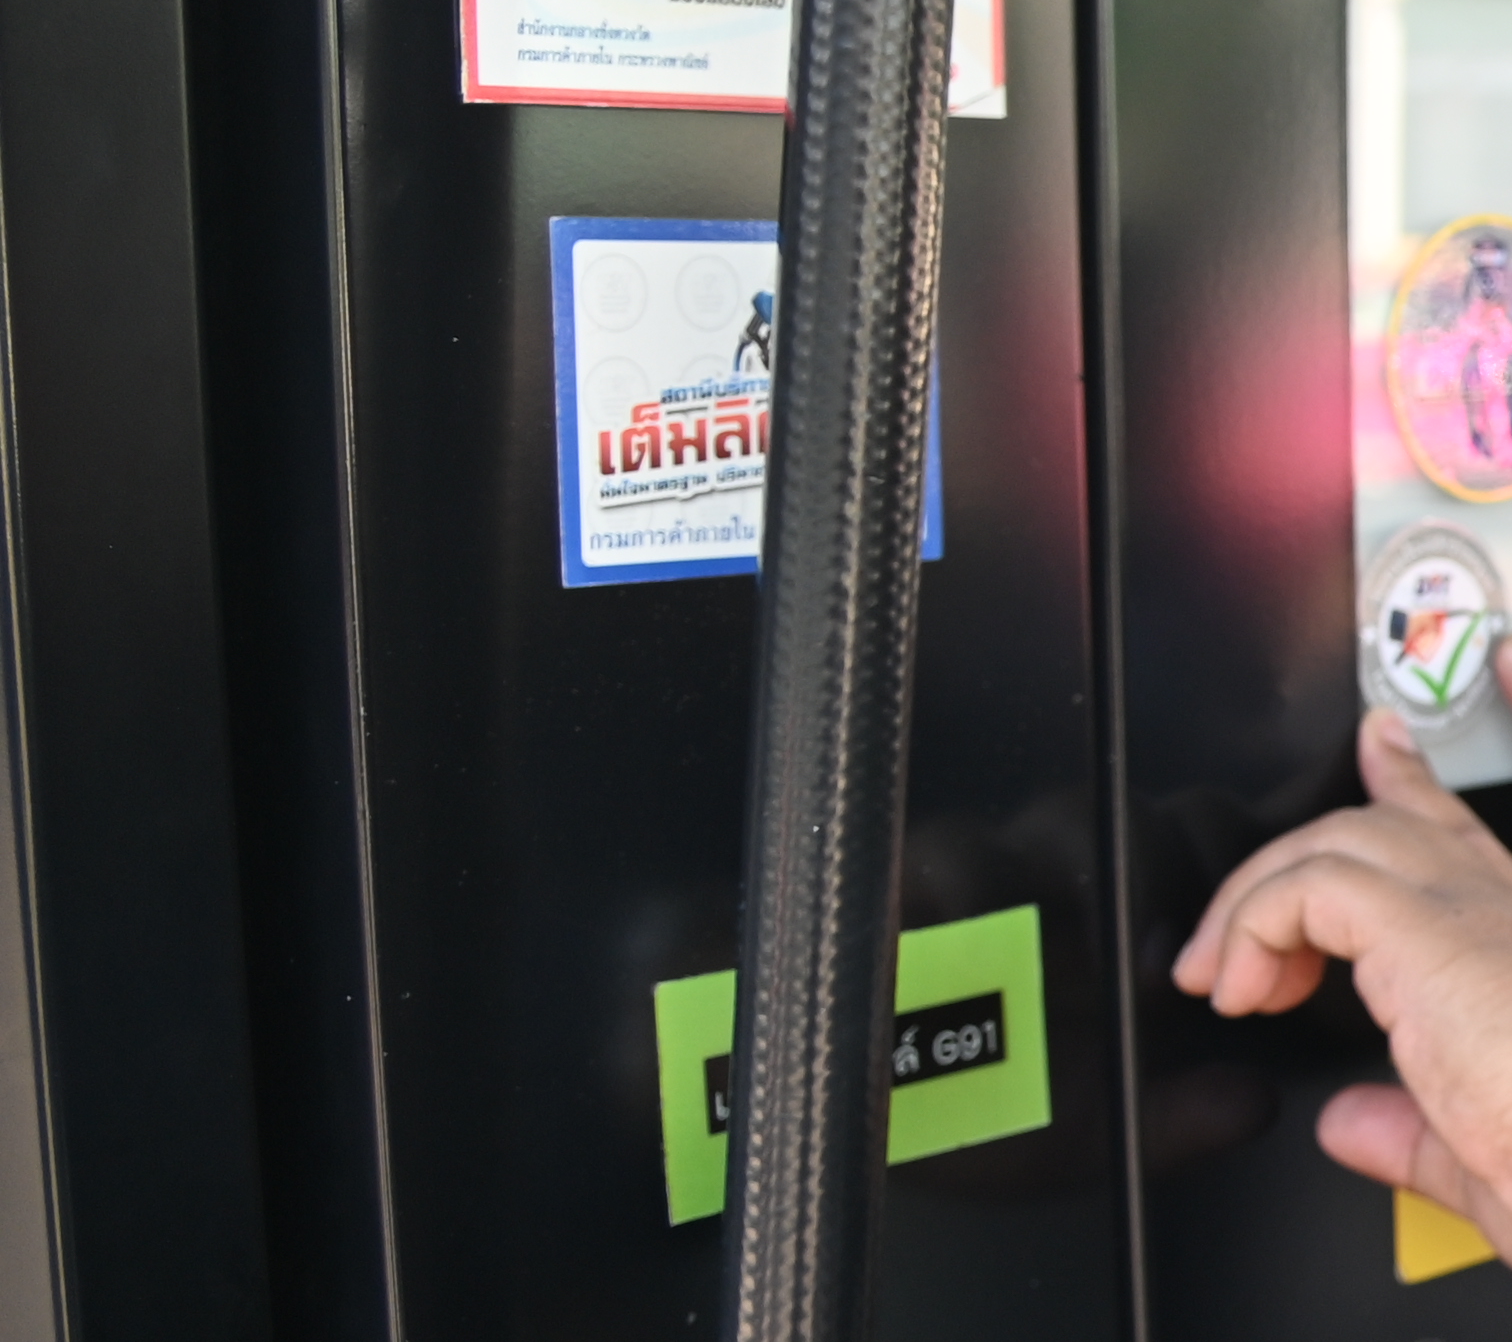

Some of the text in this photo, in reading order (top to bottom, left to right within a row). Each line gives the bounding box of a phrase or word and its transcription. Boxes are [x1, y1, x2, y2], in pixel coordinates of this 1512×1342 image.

[589, 515, 756, 551] กรมการค้าภายใน
[931, 1019, 999, 1067] G91
